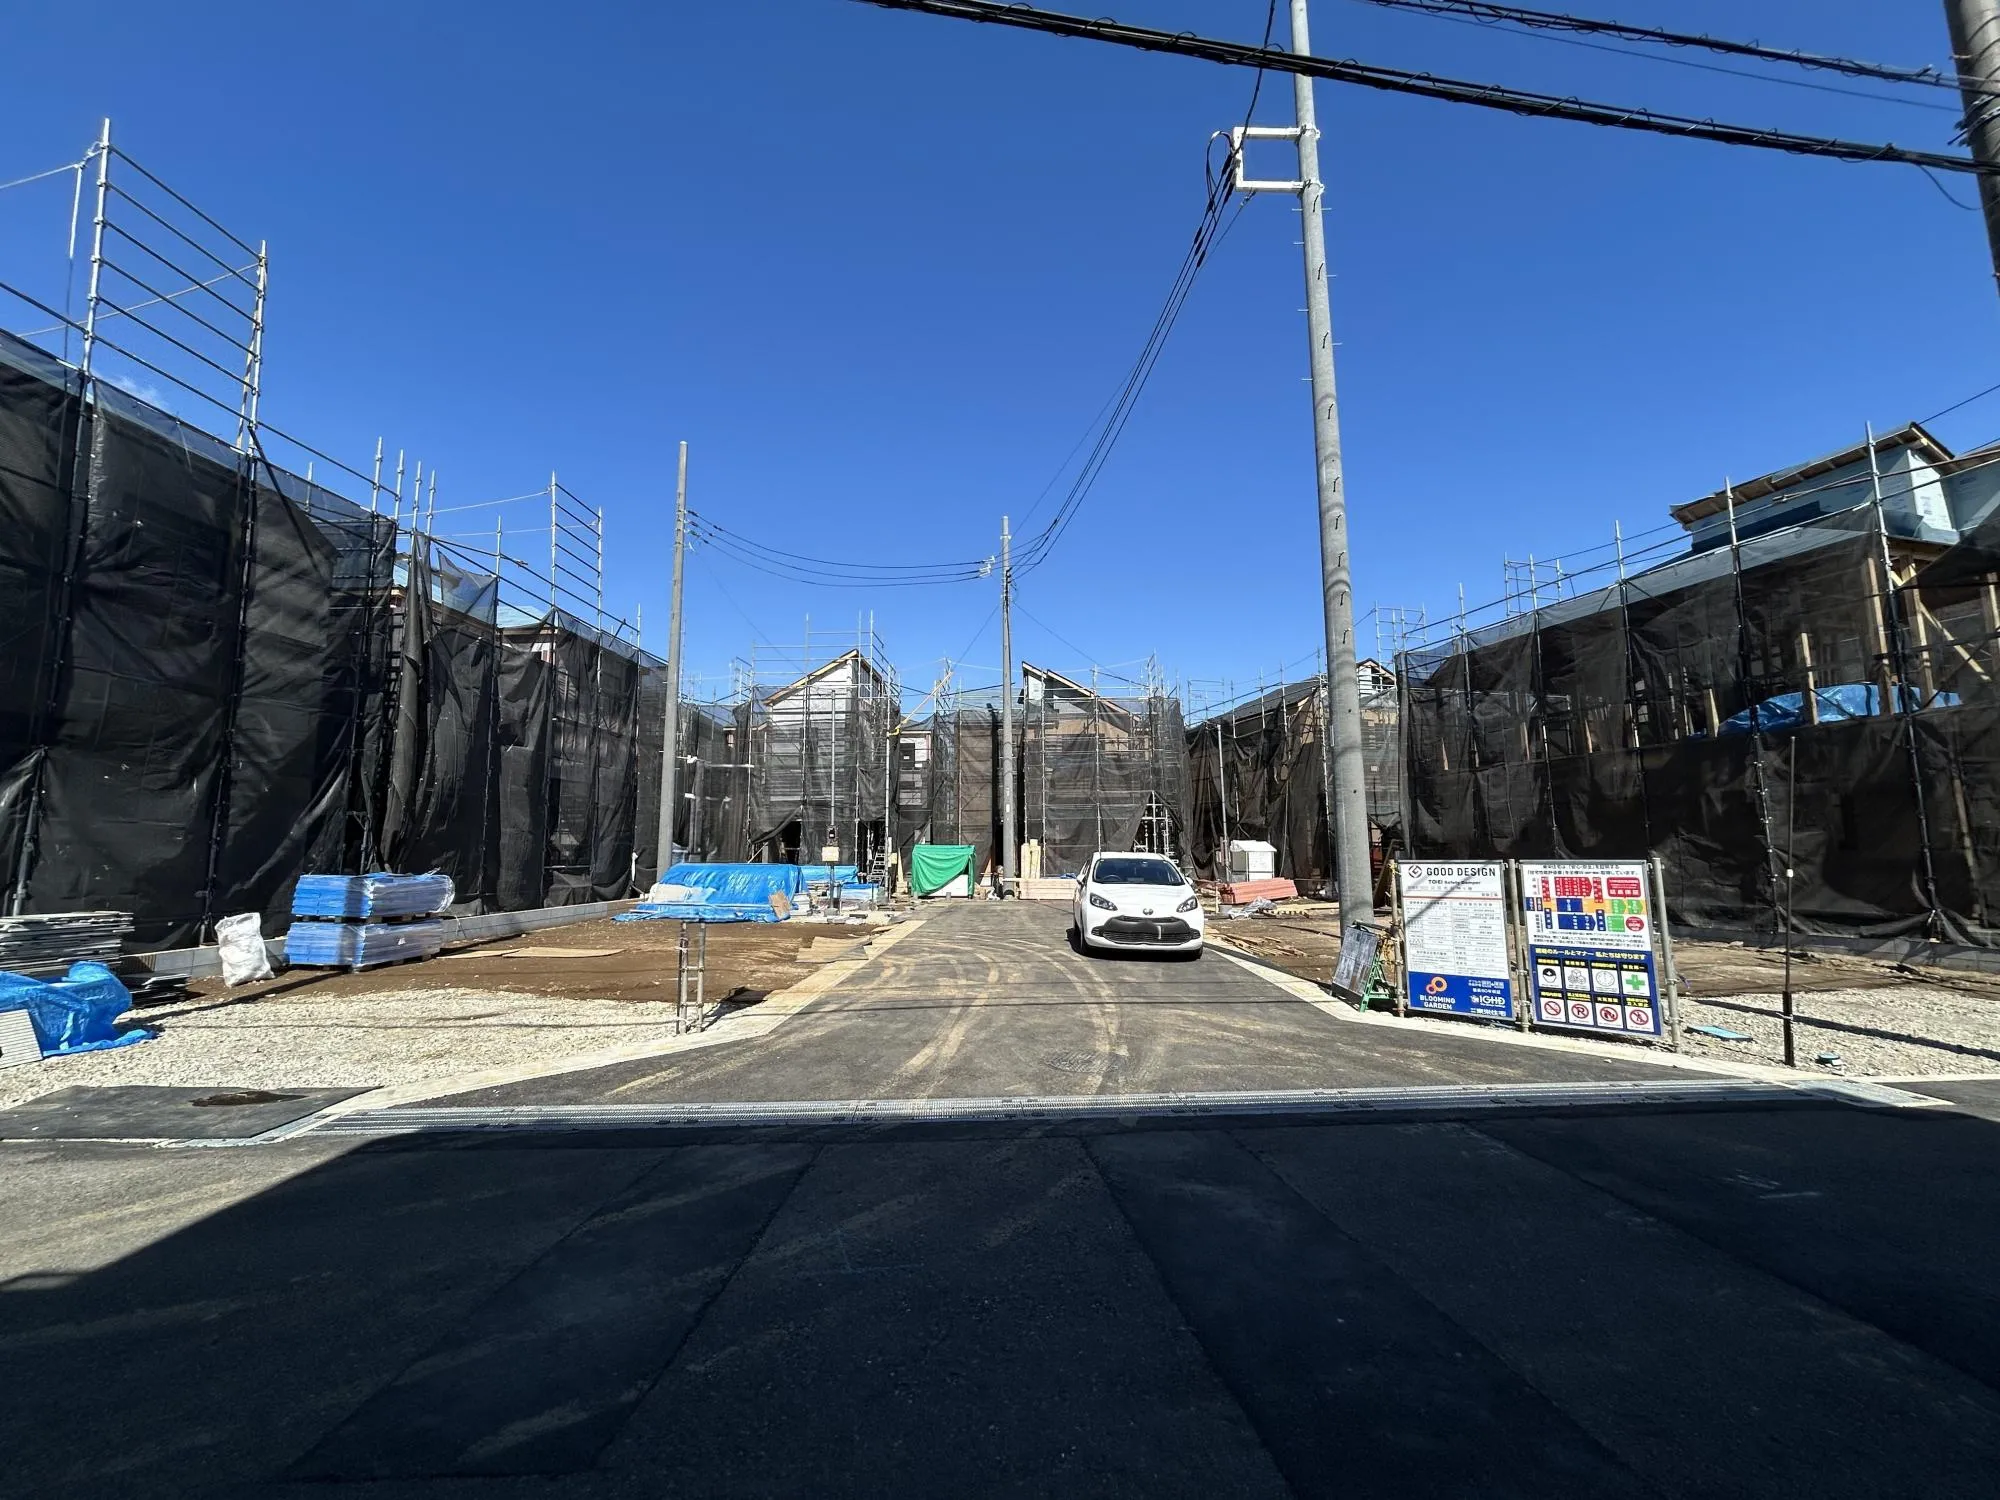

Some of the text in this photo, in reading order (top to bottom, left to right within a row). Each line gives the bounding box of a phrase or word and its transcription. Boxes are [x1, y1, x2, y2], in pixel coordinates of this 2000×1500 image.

[1426, 867, 1496, 877] GOOD DESIGN
[1419, 994, 1456, 1004] BLOOMING
[1423, 1001, 1453, 1010] GARDEN
